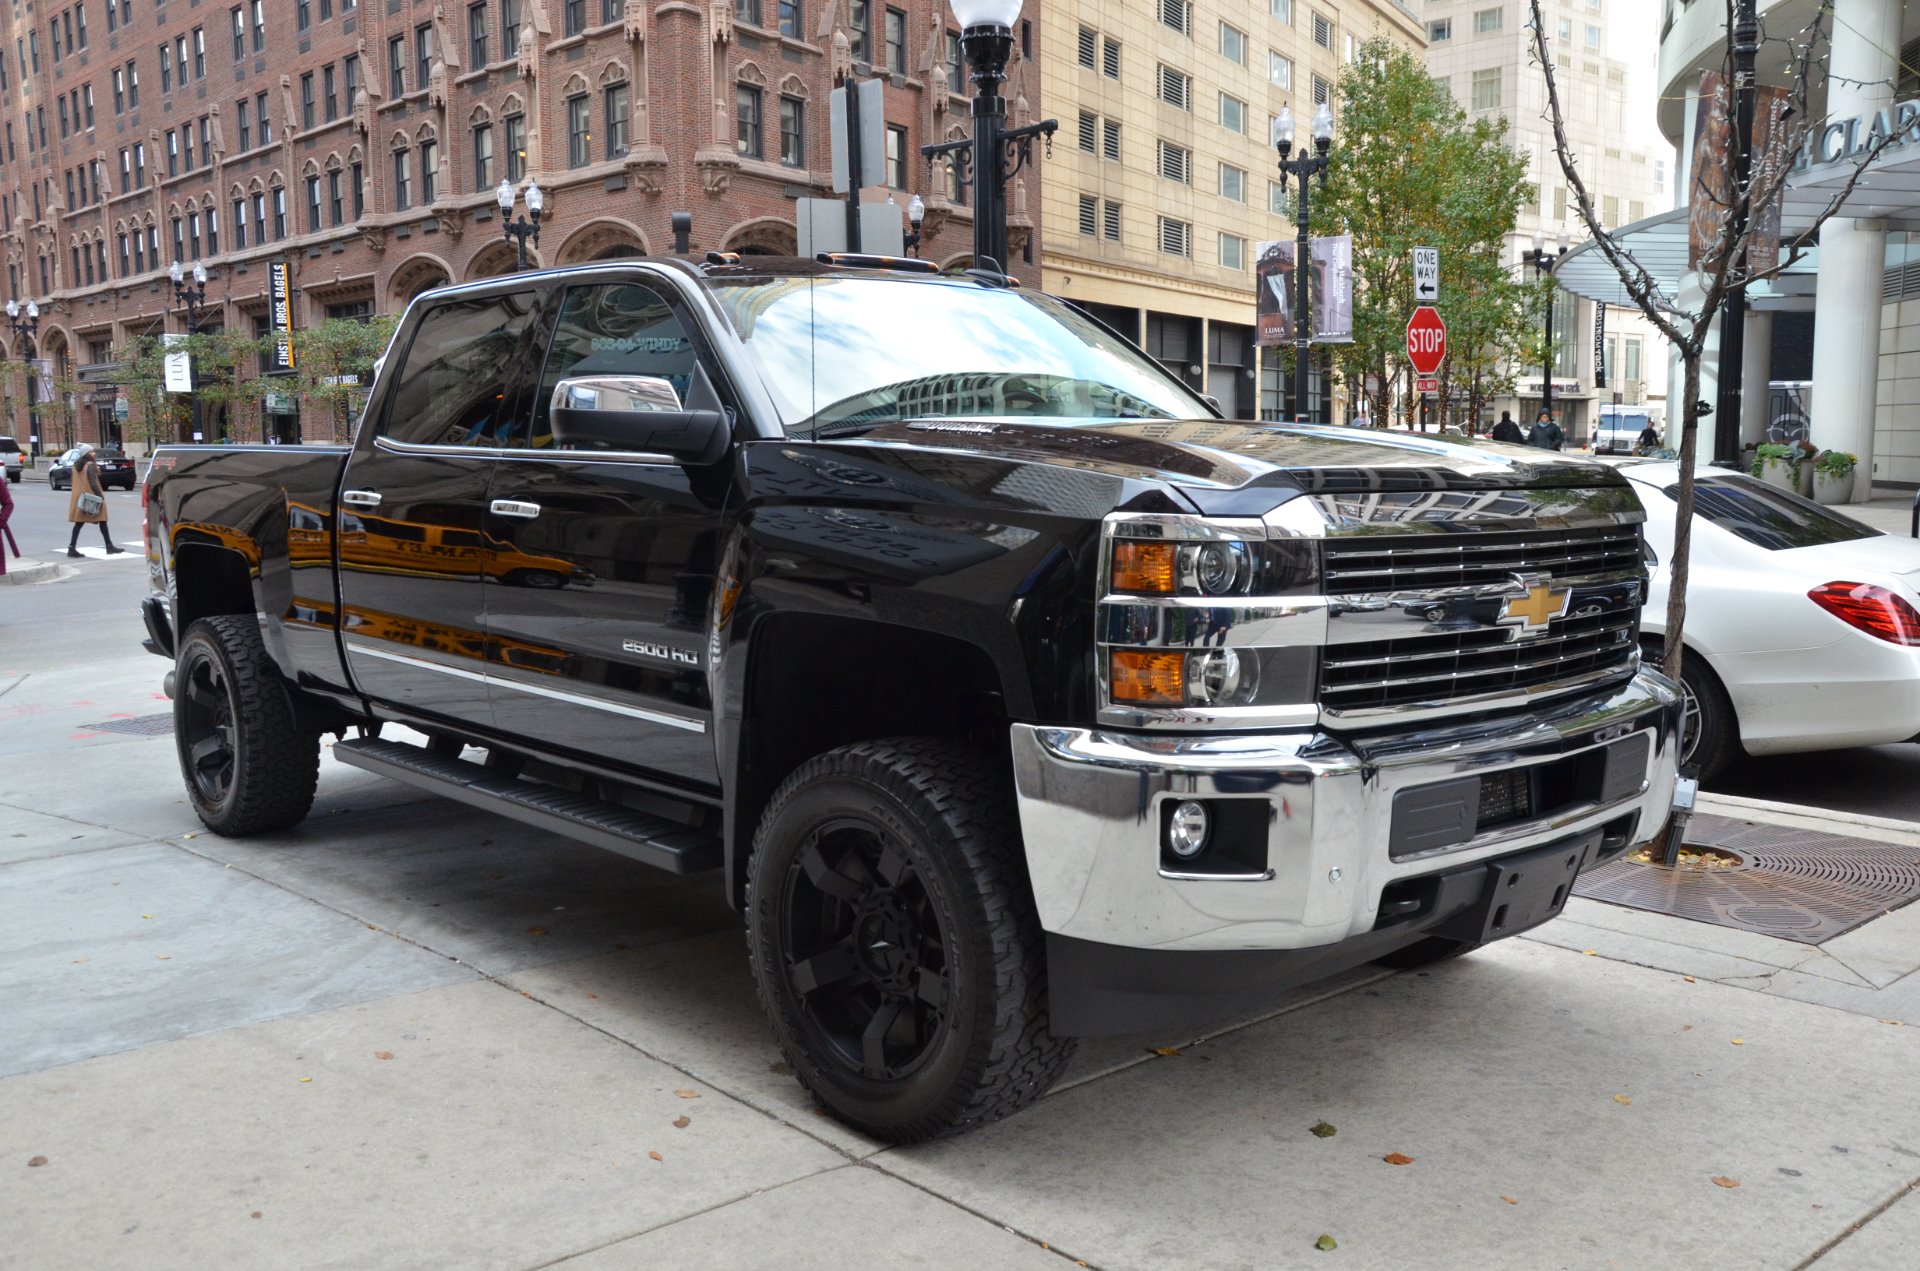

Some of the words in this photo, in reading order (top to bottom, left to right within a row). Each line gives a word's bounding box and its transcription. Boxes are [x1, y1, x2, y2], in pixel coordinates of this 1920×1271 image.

[1417, 252, 1436, 265] ONE
[273, 264, 286, 298] BAGELS
[1417, 266, 1436, 280] WAY
[275, 301, 287, 324] BROS.
[1264, 326, 1285, 334] LUMA
[1594, 302, 1604, 350] ORDSTROM
[277, 326, 290, 366] EINSTN
[1409, 327, 1443, 353] STOP
[1594, 351, 1604, 373] rack
[342, 374, 359, 384] BAGELS
[1418, 381, 1426, 390] ALL
[1426, 380, 1436, 389] WAY
[622, 639, 668, 658] 2500
[671, 647, 698, 665] HD
